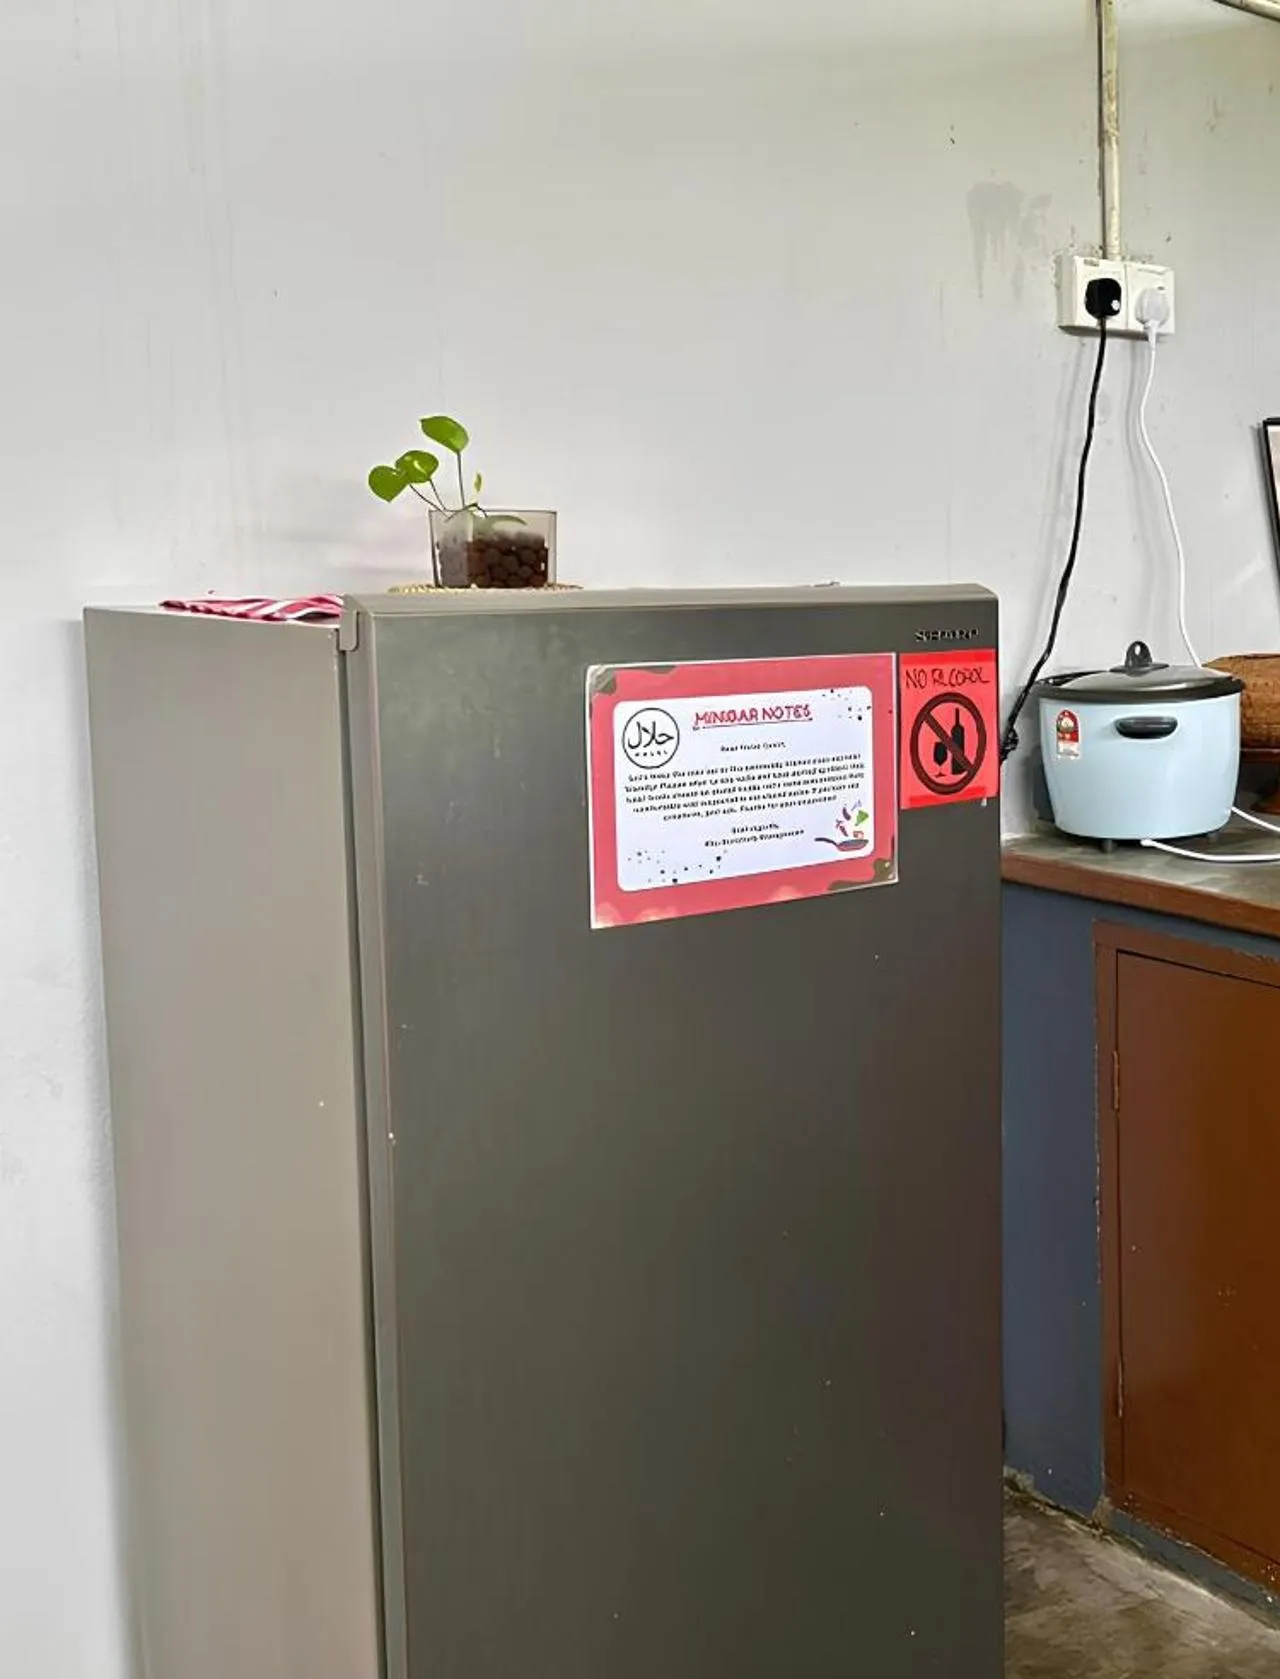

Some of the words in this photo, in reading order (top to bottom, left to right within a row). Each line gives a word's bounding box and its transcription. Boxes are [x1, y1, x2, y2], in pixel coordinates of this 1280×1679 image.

[905, 668, 928, 689] NO
[762, 703, 811, 721] NOTES
[627, 721, 674, 749] حلال
